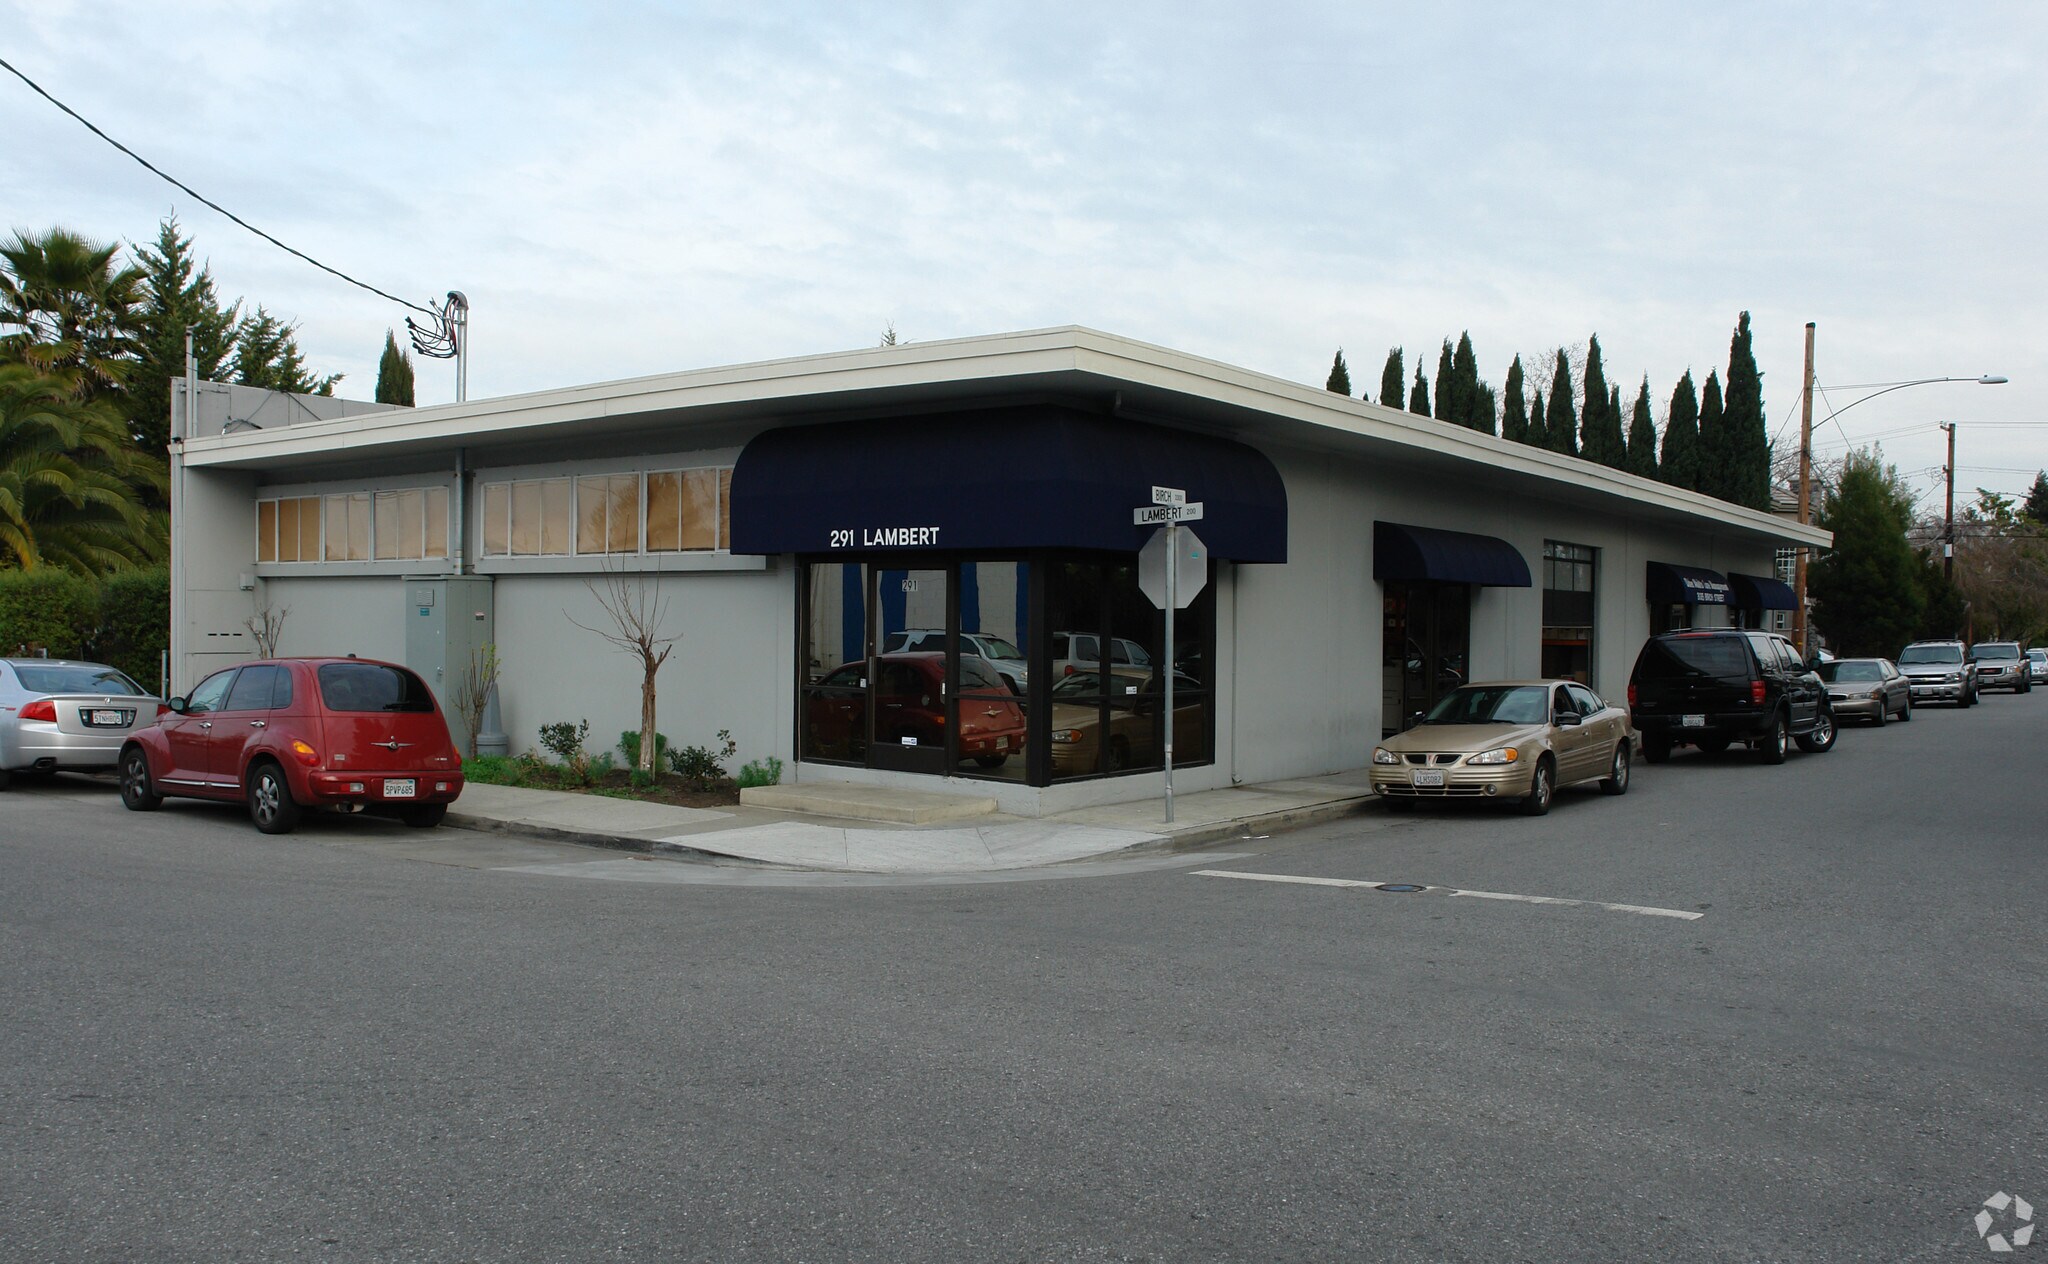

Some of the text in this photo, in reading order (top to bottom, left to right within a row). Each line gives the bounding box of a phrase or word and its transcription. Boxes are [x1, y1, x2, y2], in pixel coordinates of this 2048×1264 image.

[1155, 489, 1172, 503] BIRCH
[1141, 506, 1197, 522] LAMBERT 200
[830, 526, 940, 548] 291 LAMBERT
[902, 580, 917, 591] 291
[385, 785, 413, 795] 5PVP685
